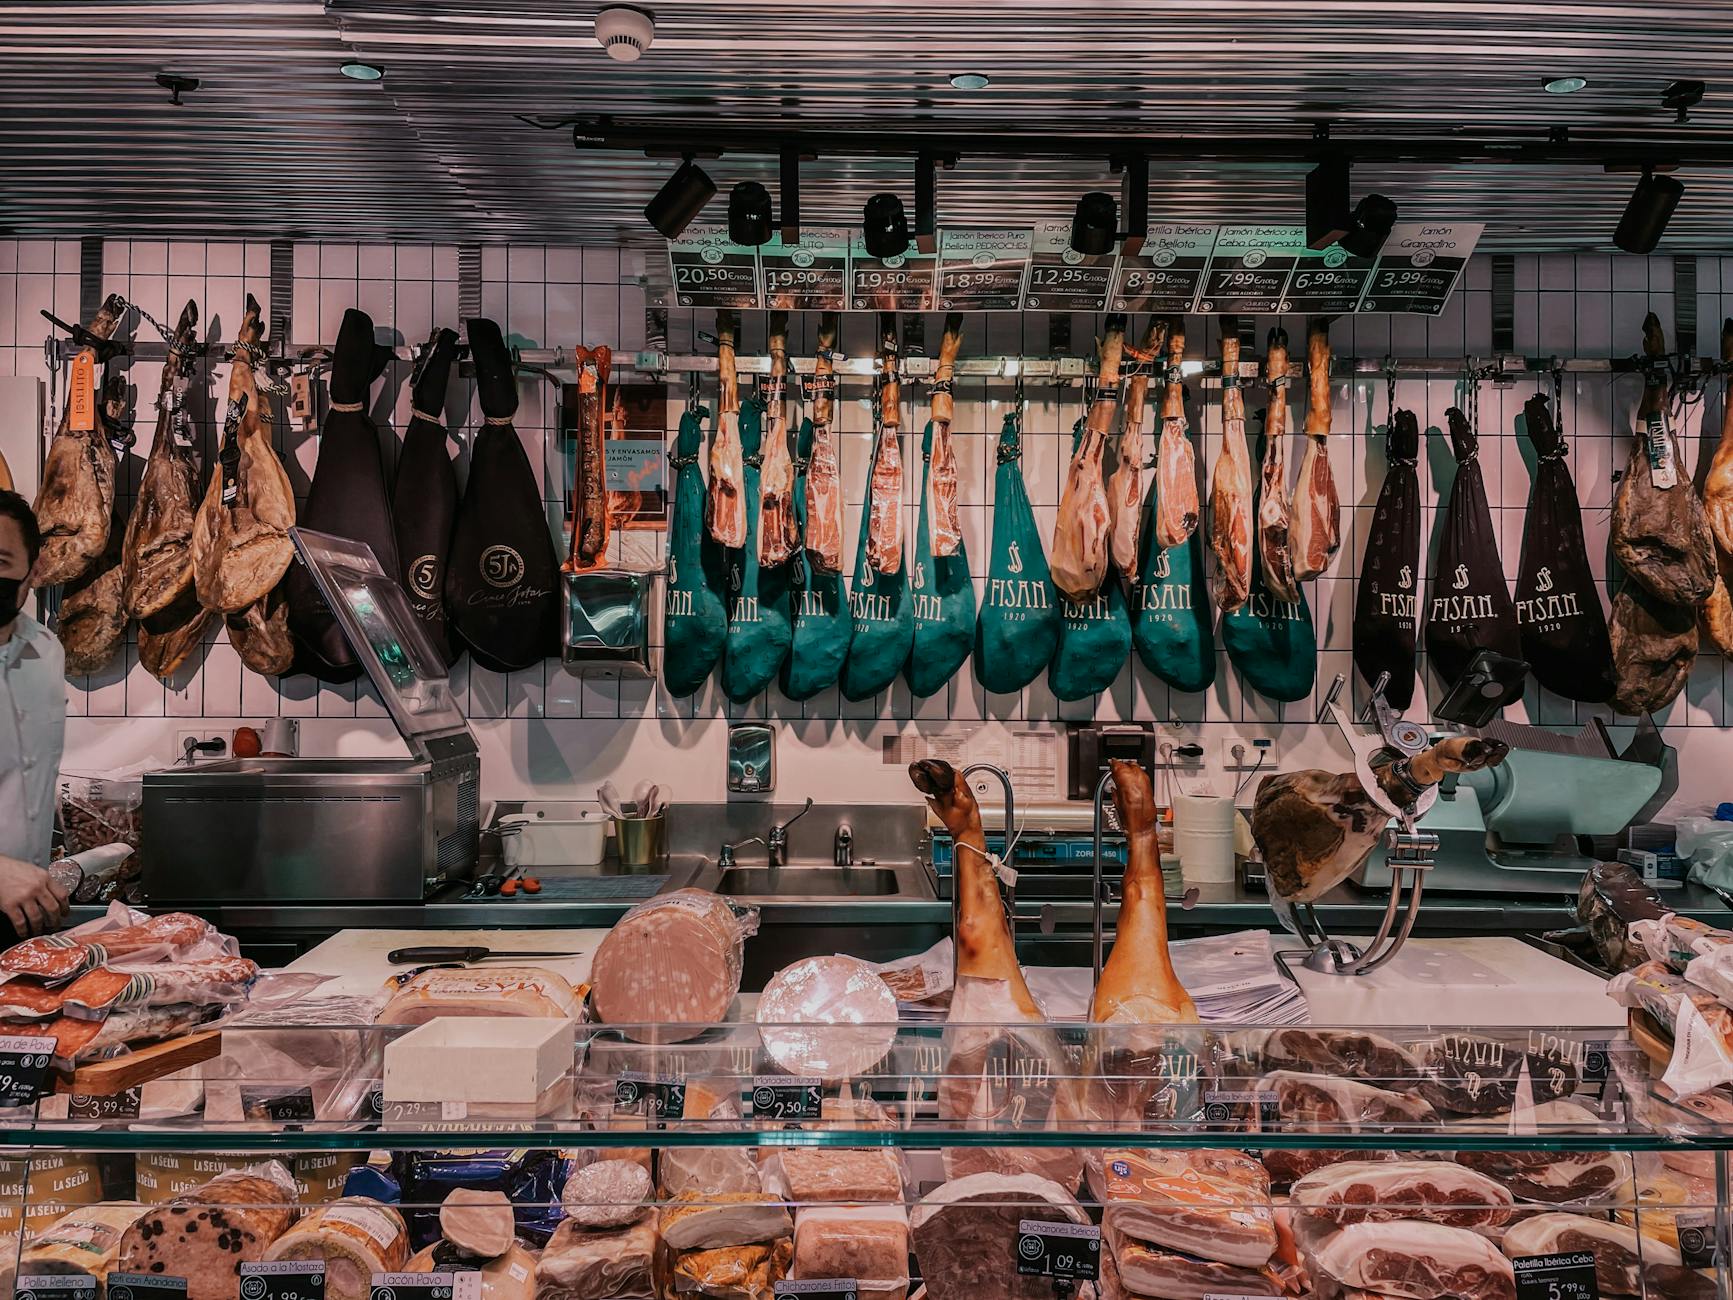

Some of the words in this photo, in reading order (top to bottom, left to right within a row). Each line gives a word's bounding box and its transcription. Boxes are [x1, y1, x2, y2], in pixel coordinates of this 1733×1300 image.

[1043, 223, 1072, 233] Jamó
[1174, 225, 1212, 235] Ibérica
[1224, 228, 1252, 236] Jamón
[1289, 228, 1303, 236] de
[1419, 226, 1452, 236] Jamón
[800, 230, 840, 239] elección
[1007, 232, 1026, 240] Puro
[976, 242, 1028, 250] PEDROCHES
[1158, 239, 1196, 249] Bellota
[990, 579, 1048, 609] FISAN
[1132, 584, 1192, 610] FISAN
[1430, 594, 1492, 622] FISAN
[1516, 592, 1580, 625] FISAN
[1003, 612, 1026, 621] 1920
[1148, 614, 1174, 623] 1920
[1067, 622, 1089, 631] 1920
[1538, 622, 1561, 633] 1920
[16, 1039, 28, 1050] de
[30, 1038, 55, 1051] Pavo
[36, 1157, 64, 1170] SELVA
[151, 1155, 159, 1166] LA
[158, 1155, 179, 1169] SELVA
[194, 1160, 202, 1172] LA
[202, 1159, 228, 1173] SELVA
[300, 1159, 309, 1171] LA
[310, 1155, 338, 1170] SELVA
[54, 1180, 64, 1192] LA
[65, 1172, 90, 1189] SELVA
[141, 1174, 158, 1190] SELVA
[171, 1180, 179, 1192] LA
[327, 1178, 336, 1190] LA
[2, 1185, 11, 1196] LA
[26, 1206, 37, 1217] LA
[37, 1204, 66, 1217] SELVA
[1021, 1221, 1069, 1234] Chicharrones
[241, 1261, 269, 1273] Asado
[279, 1262, 288, 1272] la
[289, 1260, 325, 1272] Mostaza
[1513, 1259, 1544, 1269] Paletilla
[1544, 1256, 1571, 1267] Ibérica
[1572, 1254, 1594, 1264] Cebo
[24, 1276, 47, 1288] Pollo
[50, 1276, 84, 1288] Relleno
[126, 1276, 142, 1284] con
[382, 1272, 413, 1286] Lacón
[416, 1273, 442, 1286] Pavo
[776, 1281, 832, 1292] Chicharrones
[834, 1279, 856, 1290] Fritos
